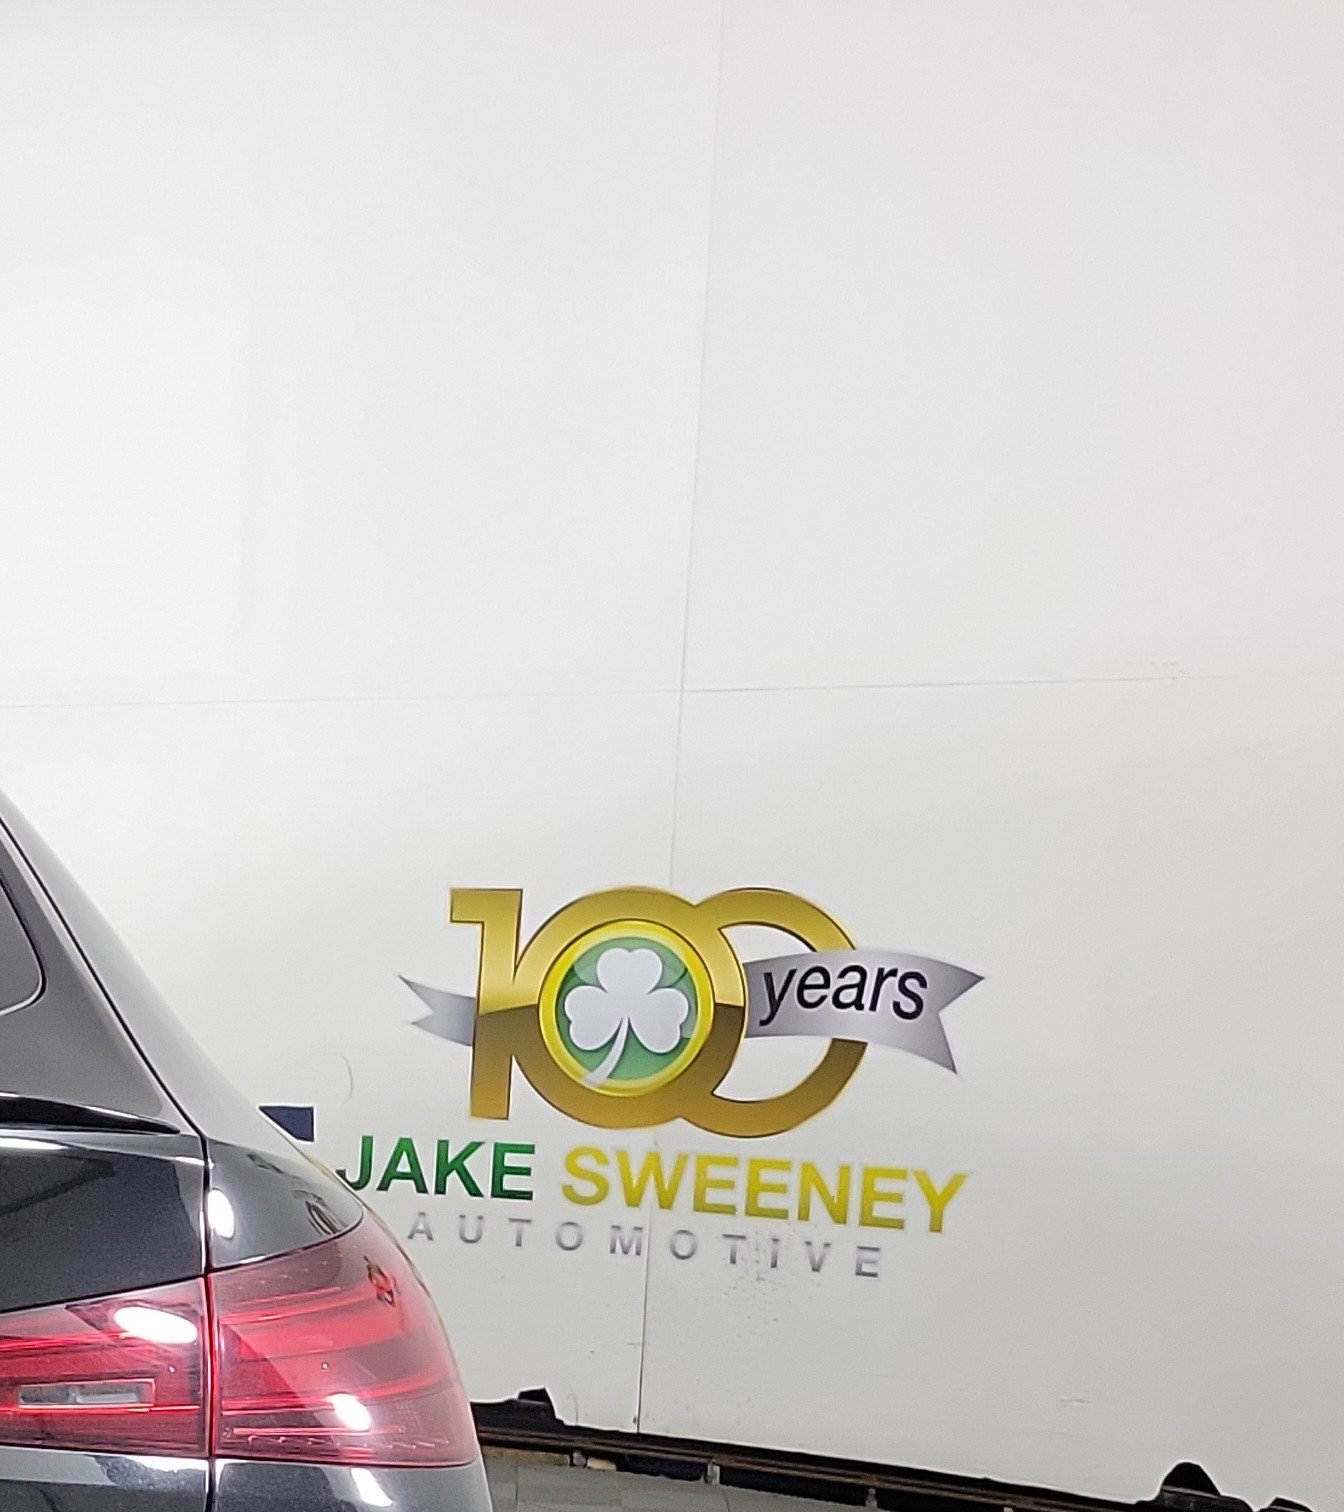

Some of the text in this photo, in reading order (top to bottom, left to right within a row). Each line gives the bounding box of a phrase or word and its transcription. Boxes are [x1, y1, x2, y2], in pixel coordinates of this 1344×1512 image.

[449, 886, 929, 1139] 100 years
[335, 1134, 969, 1235] JAKE SWEENEY
[407, 1210, 882, 1279] AUTOMOTIVE
